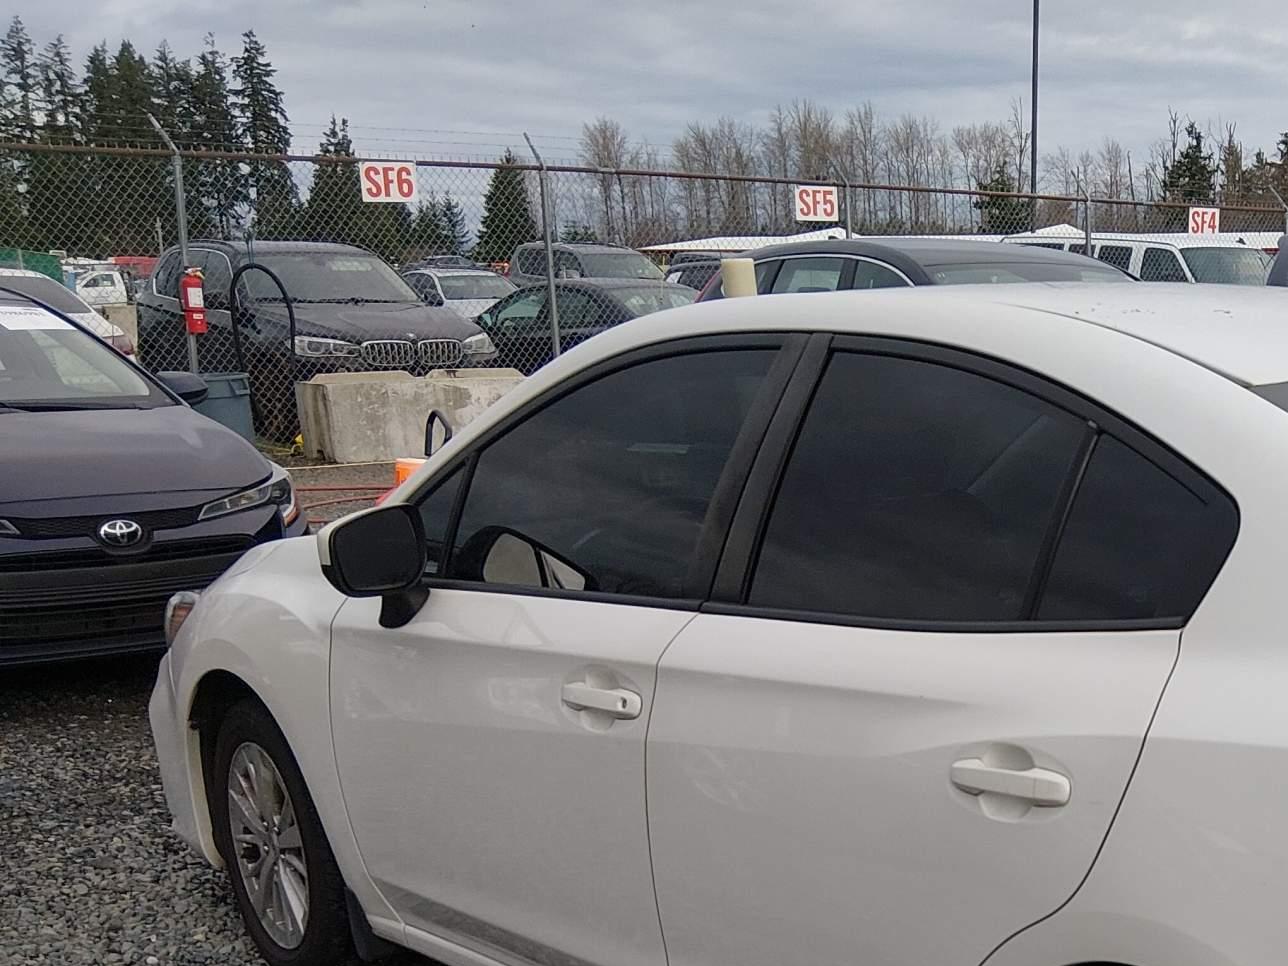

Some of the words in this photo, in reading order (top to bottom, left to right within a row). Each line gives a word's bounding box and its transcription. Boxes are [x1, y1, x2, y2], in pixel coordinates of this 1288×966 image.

[364, 166, 414, 198] SF6
[798, 189, 835, 217] SF5
[1191, 210, 1217, 234] SF4
